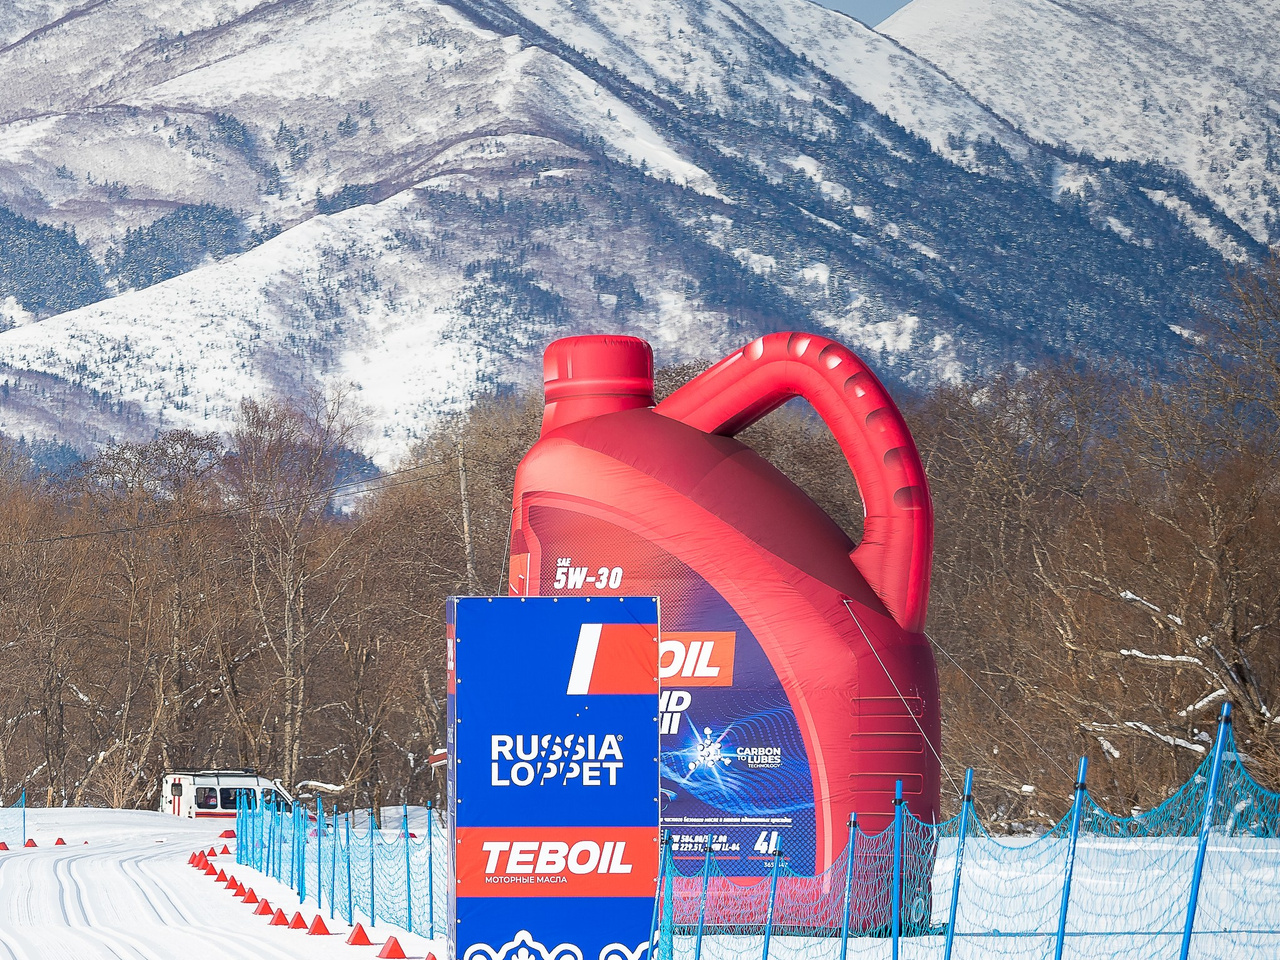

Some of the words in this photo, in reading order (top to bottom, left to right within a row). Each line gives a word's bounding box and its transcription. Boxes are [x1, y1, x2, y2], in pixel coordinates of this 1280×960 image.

[556, 558, 571, 566] SAE
[553, 567, 623, 589] 5W-30
[659, 640, 720, 678] OIL
[491, 734, 623, 760] RUSSIA
[737, 747, 781, 755] CARBON
[748, 755, 781, 763] LUBES
[491, 761, 623, 786] LOPPET
[482, 840, 633, 874] TEBOIL
[485, 875, 535, 884] МОТОРНЫЕ
[536, 875, 567, 884] МАСЛА
